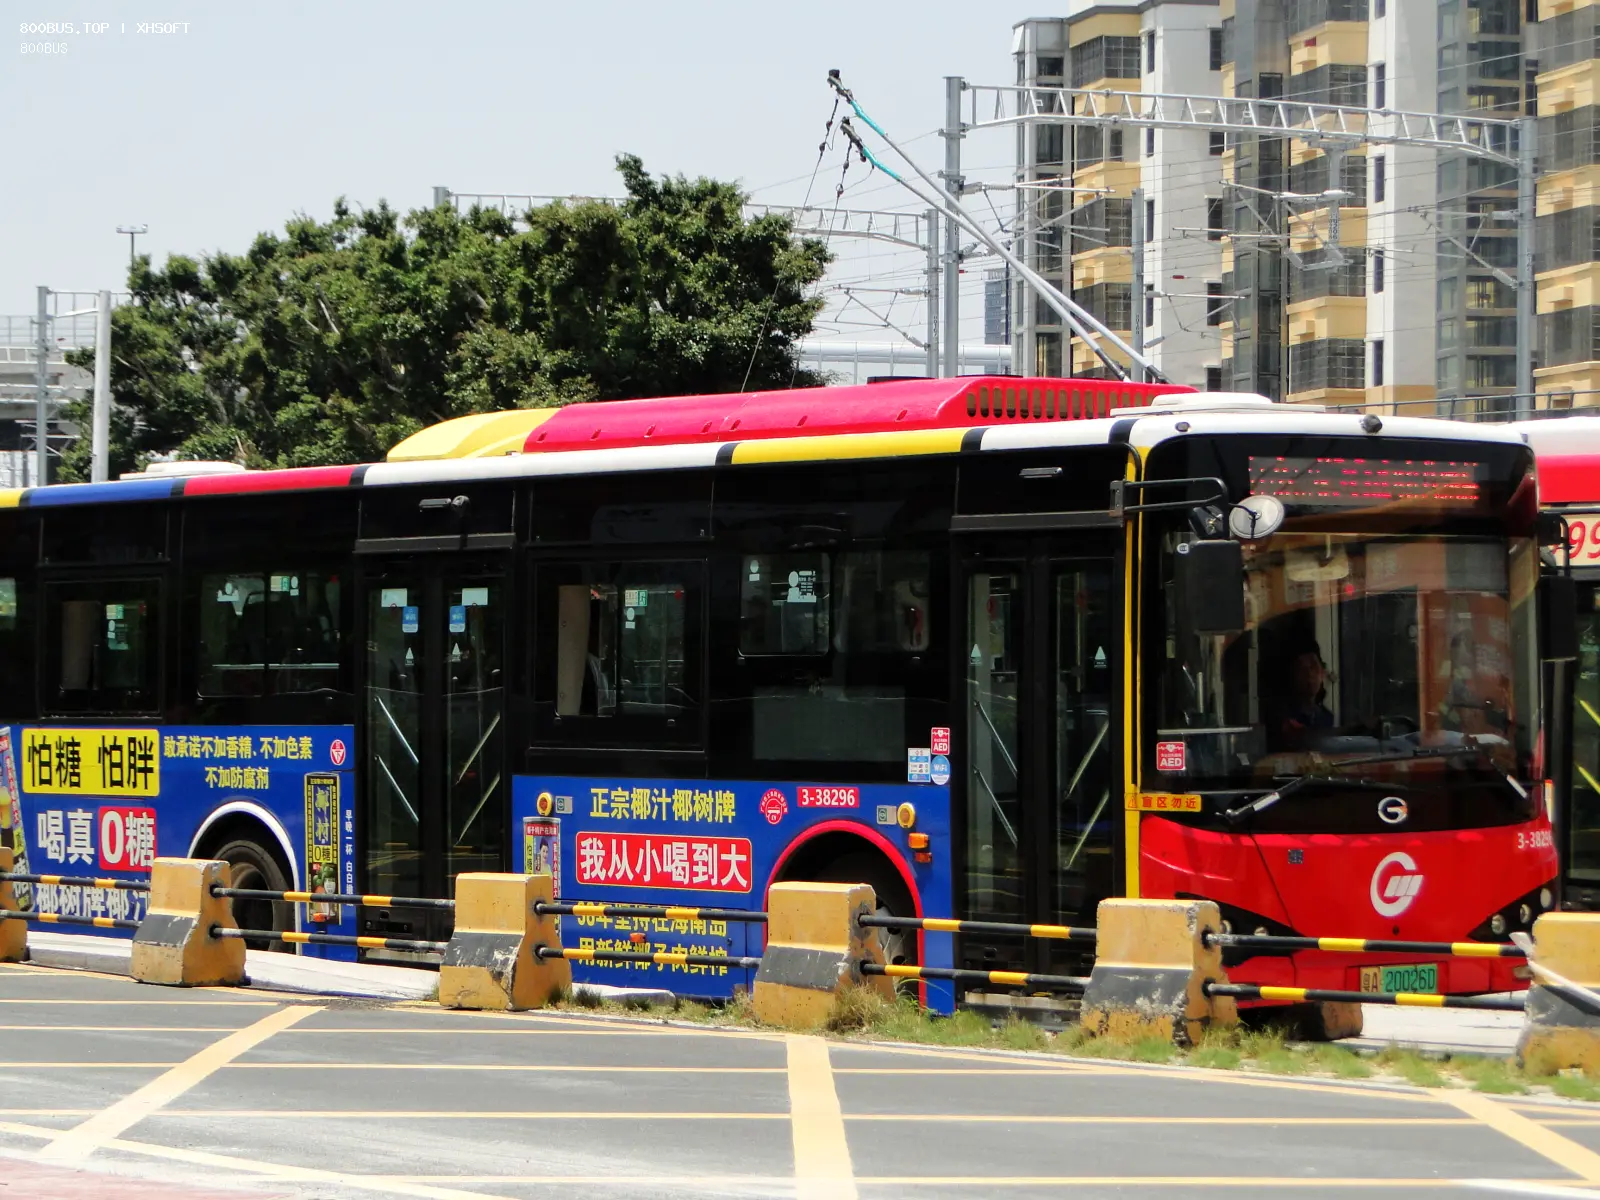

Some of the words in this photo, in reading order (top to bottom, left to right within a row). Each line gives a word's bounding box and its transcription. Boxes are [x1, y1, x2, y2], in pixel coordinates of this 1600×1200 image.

[1552, 520, 1600, 559] 99
[164, 736, 313, 759] 敢承诺不加香精、不加色素
[934, 742, 948, 751] AED
[28, 735, 81, 787] 怕糖
[98, 735, 154, 790] 怕胖
[1160, 758, 1182, 767] AED
[205, 766, 269, 789] 不加防腐剂
[590, 787, 736, 823] 正宗椰汁椰树牌
[801, 788, 855, 806] 3-38296
[1142, 796, 1197, 809] 盲区勿近
[580, 837, 748, 888] 我从小喝到大
